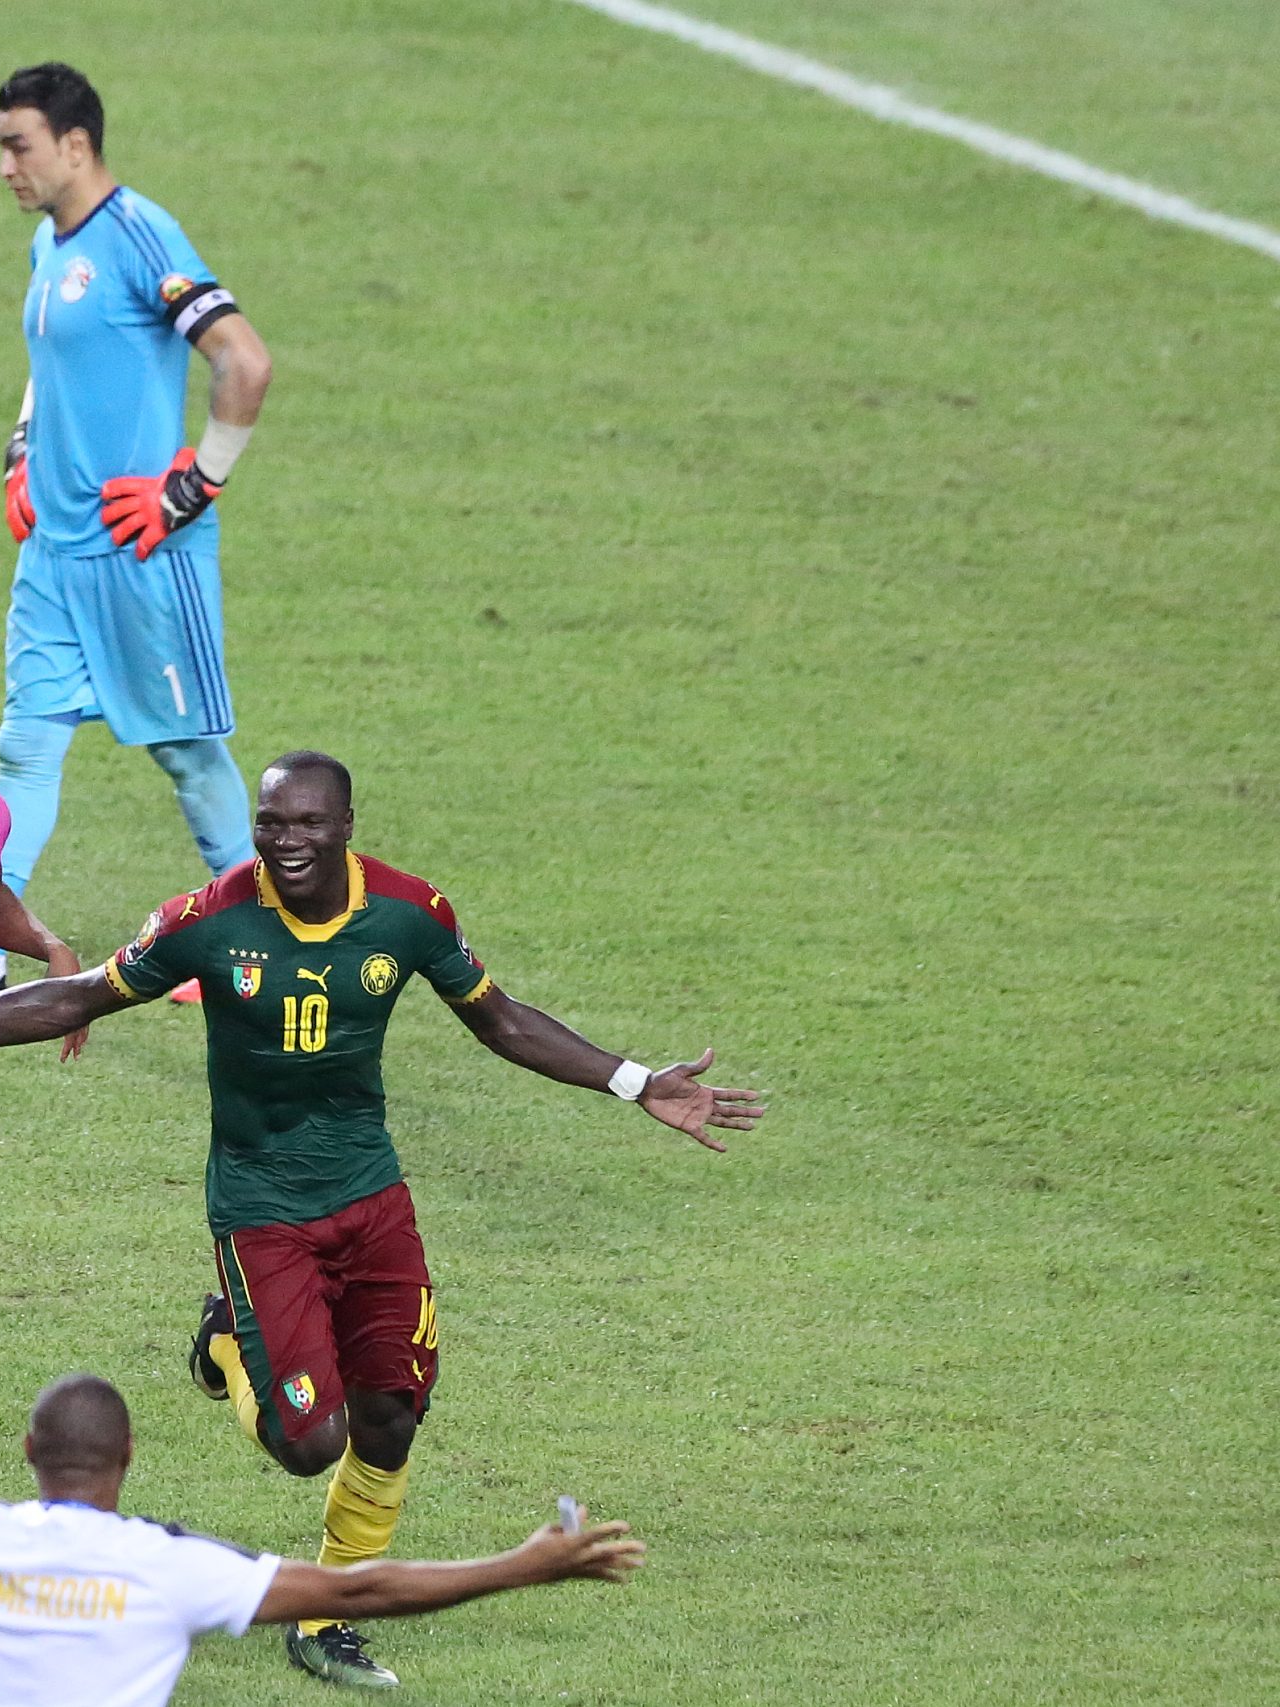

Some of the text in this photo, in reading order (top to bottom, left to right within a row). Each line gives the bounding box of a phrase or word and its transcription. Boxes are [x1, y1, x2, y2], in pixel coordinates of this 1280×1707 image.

[163, 663, 187, 717] 1
[282, 993, 329, 1053] 10
[411, 1285, 439, 1350] 10
